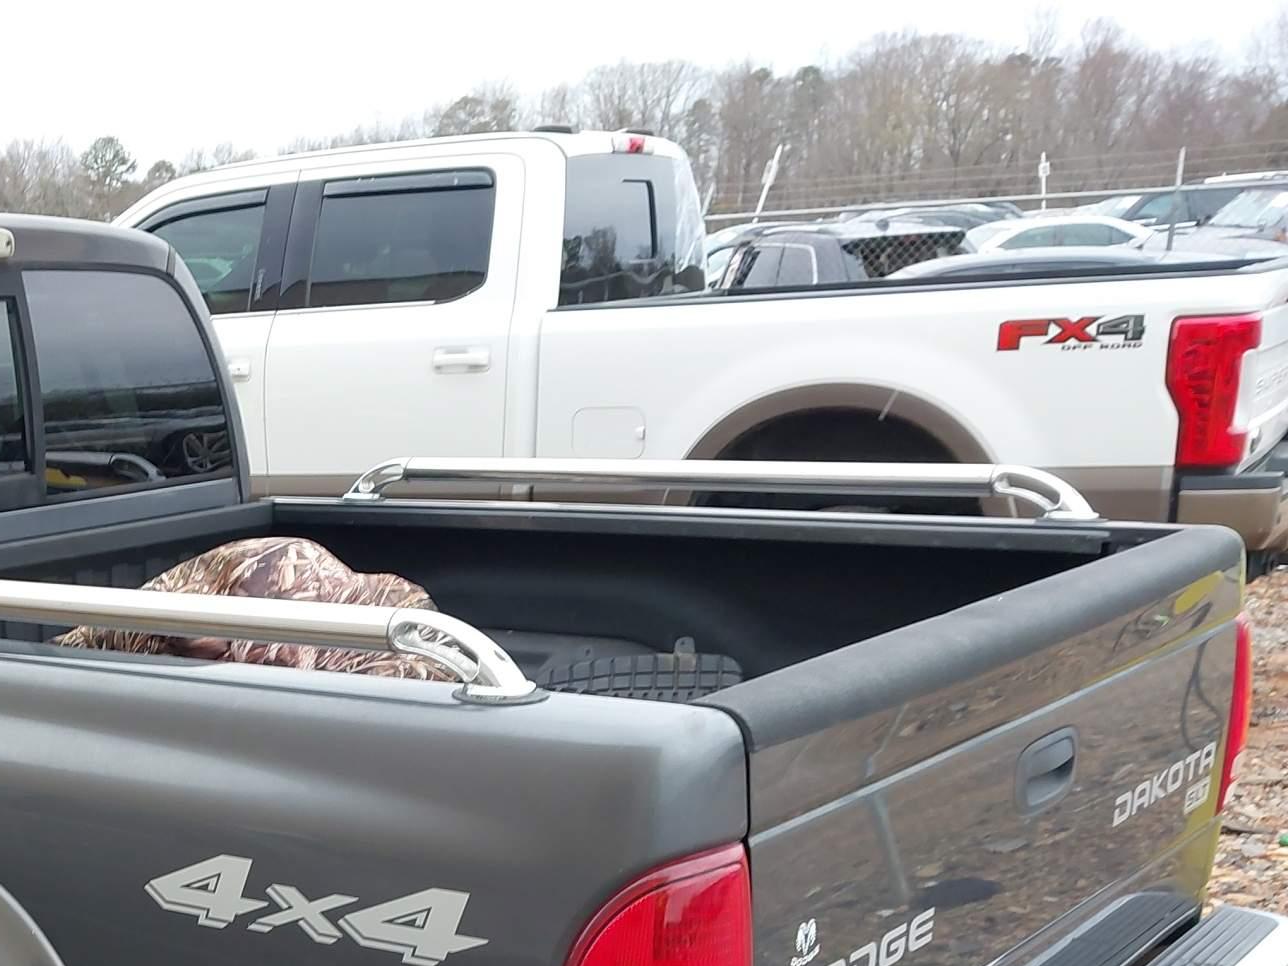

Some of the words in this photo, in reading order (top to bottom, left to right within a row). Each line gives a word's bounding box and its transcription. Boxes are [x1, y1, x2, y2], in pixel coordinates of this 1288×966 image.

[997, 314, 1145, 351] FX4
[1099, 342, 1143, 350] ROAD
[1112, 741, 1216, 828] DAKOTA
